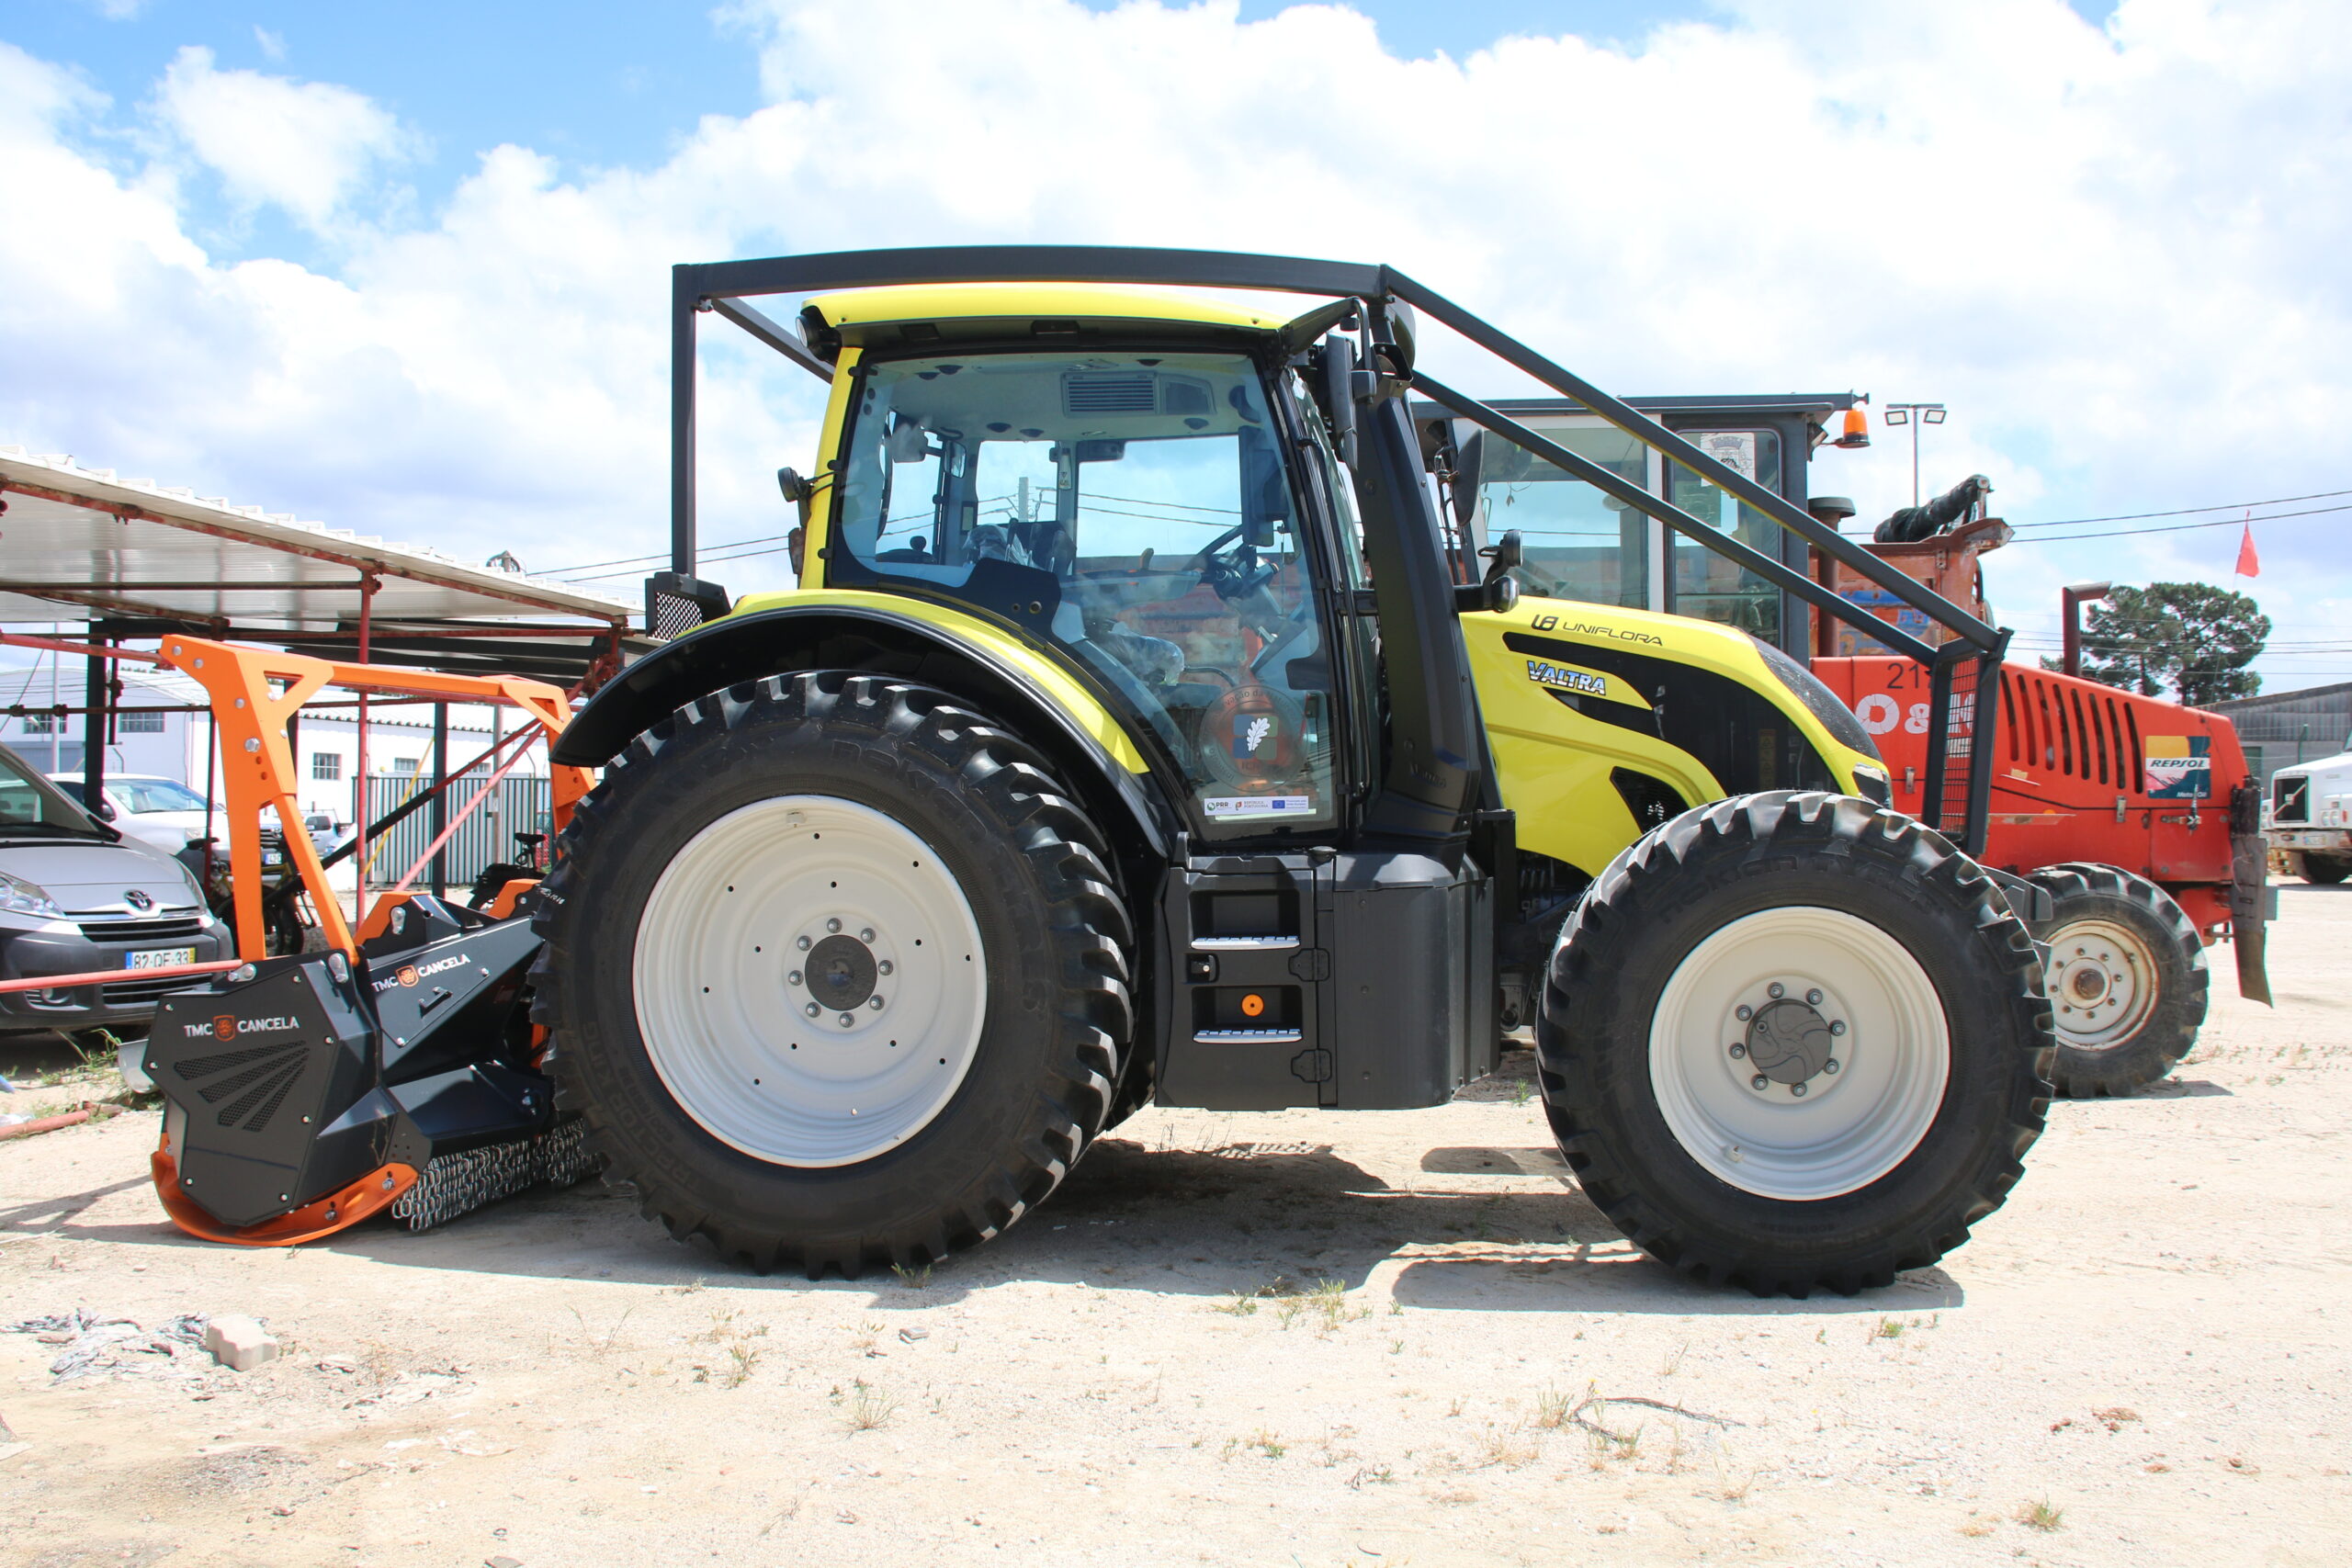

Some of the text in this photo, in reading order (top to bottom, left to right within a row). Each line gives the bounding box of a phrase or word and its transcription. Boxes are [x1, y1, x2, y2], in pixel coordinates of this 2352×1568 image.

[1563, 622, 1663, 646] UNIFLORA
[1527, 660, 1606, 695] VALTRA
[1887, 662, 1931, 689] 21
[2151, 760, 2205, 768] REPSOL
[372, 953, 470, 992] TMC CANCELA
[184, 1017, 300, 1037] TMC CANCELA
